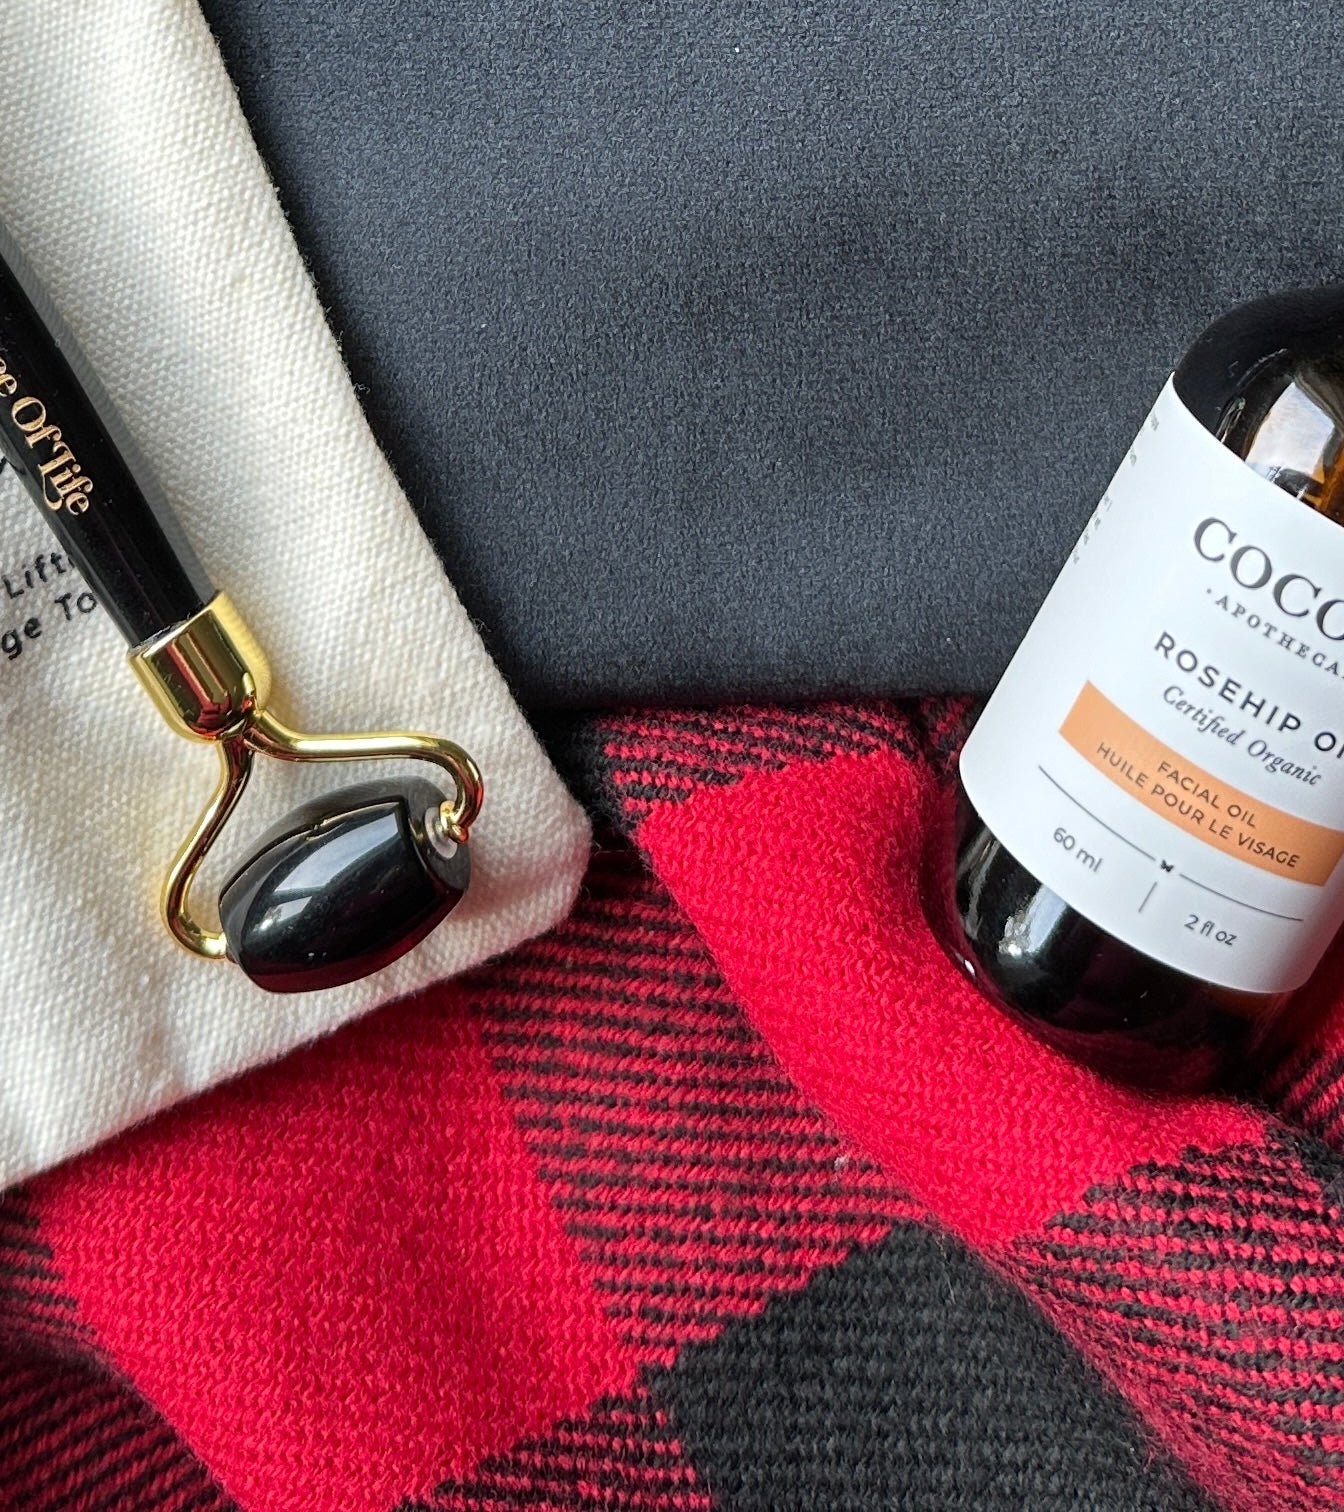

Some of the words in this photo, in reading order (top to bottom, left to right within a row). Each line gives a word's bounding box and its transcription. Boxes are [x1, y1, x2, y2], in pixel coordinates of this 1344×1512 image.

[11, 396, 62, 449] Of
[38, 439, 94, 516] Life
[2, 552, 75, 599] Lift
[1153, 631, 1302, 733] ROSEHIP
[1163, 684, 1246, 746] Certified
[1247, 739, 1323, 787] Organic
[1096, 741, 1148, 789] HUILE
[1151, 783, 1205, 825] POUR
[1208, 819, 1233, 840] LE
[1238, 832, 1301, 868] VISAGE
[1157, 760, 1220, 809] FACIAL
[1227, 804, 1257, 829] OIL
[1053, 827, 1076, 851] 60
[1076, 848, 1104, 873] ml
[1184, 914, 1199, 931] 2
[1199, 920, 1216, 937] fl
[1216, 929, 1238, 947] oz
